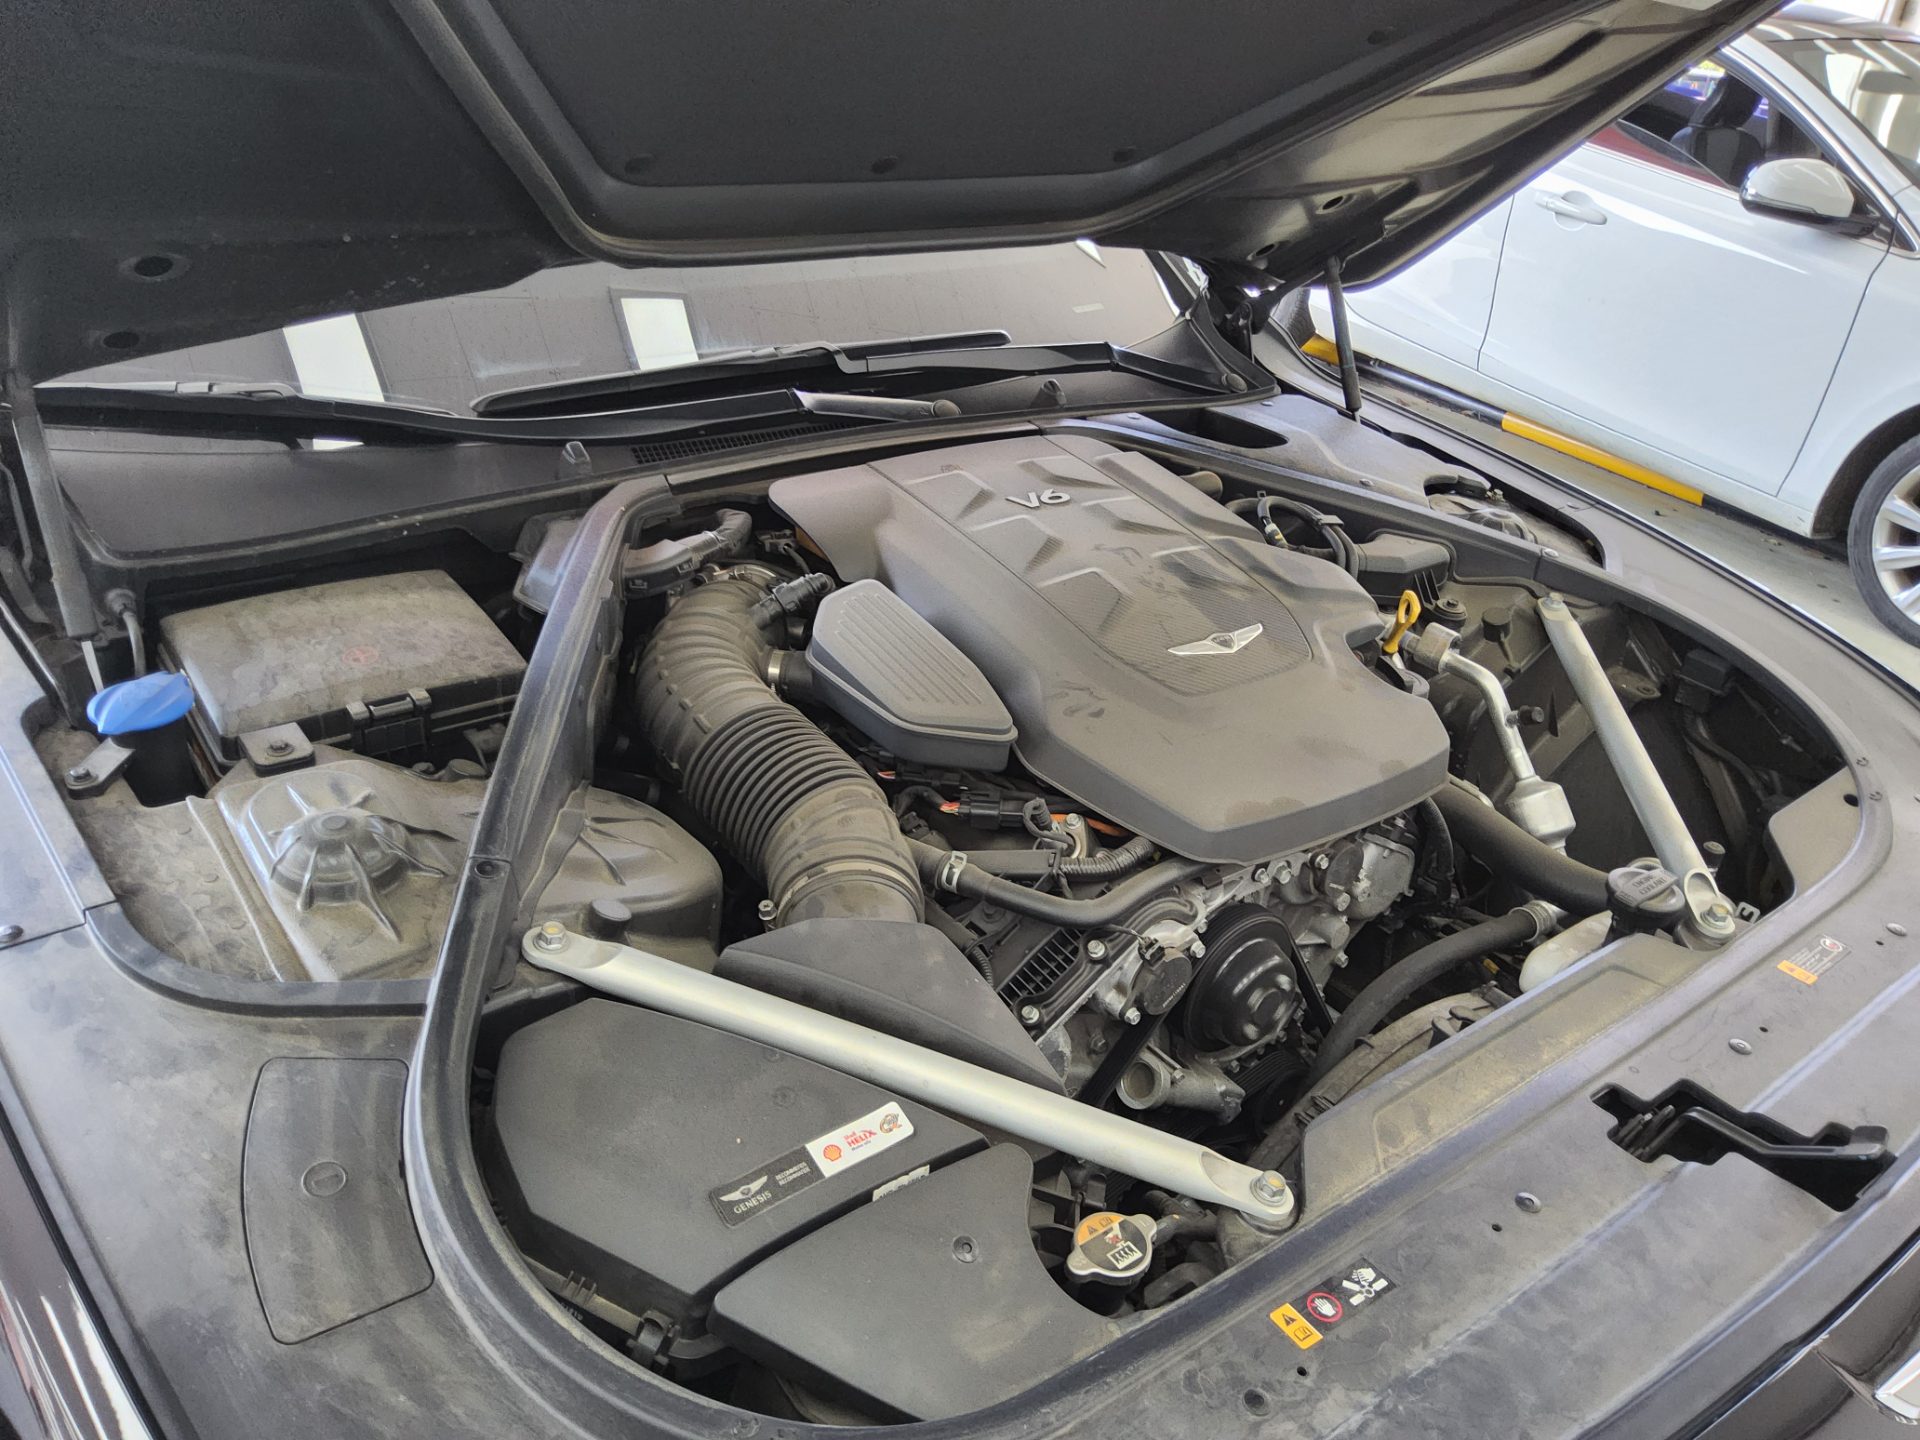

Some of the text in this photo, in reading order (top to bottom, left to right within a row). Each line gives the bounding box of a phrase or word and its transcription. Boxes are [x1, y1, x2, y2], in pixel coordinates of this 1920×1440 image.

[1005, 489, 1070, 508] V6
[847, 1129, 877, 1147] HELIX
[733, 1191, 772, 1214] GENESIS
